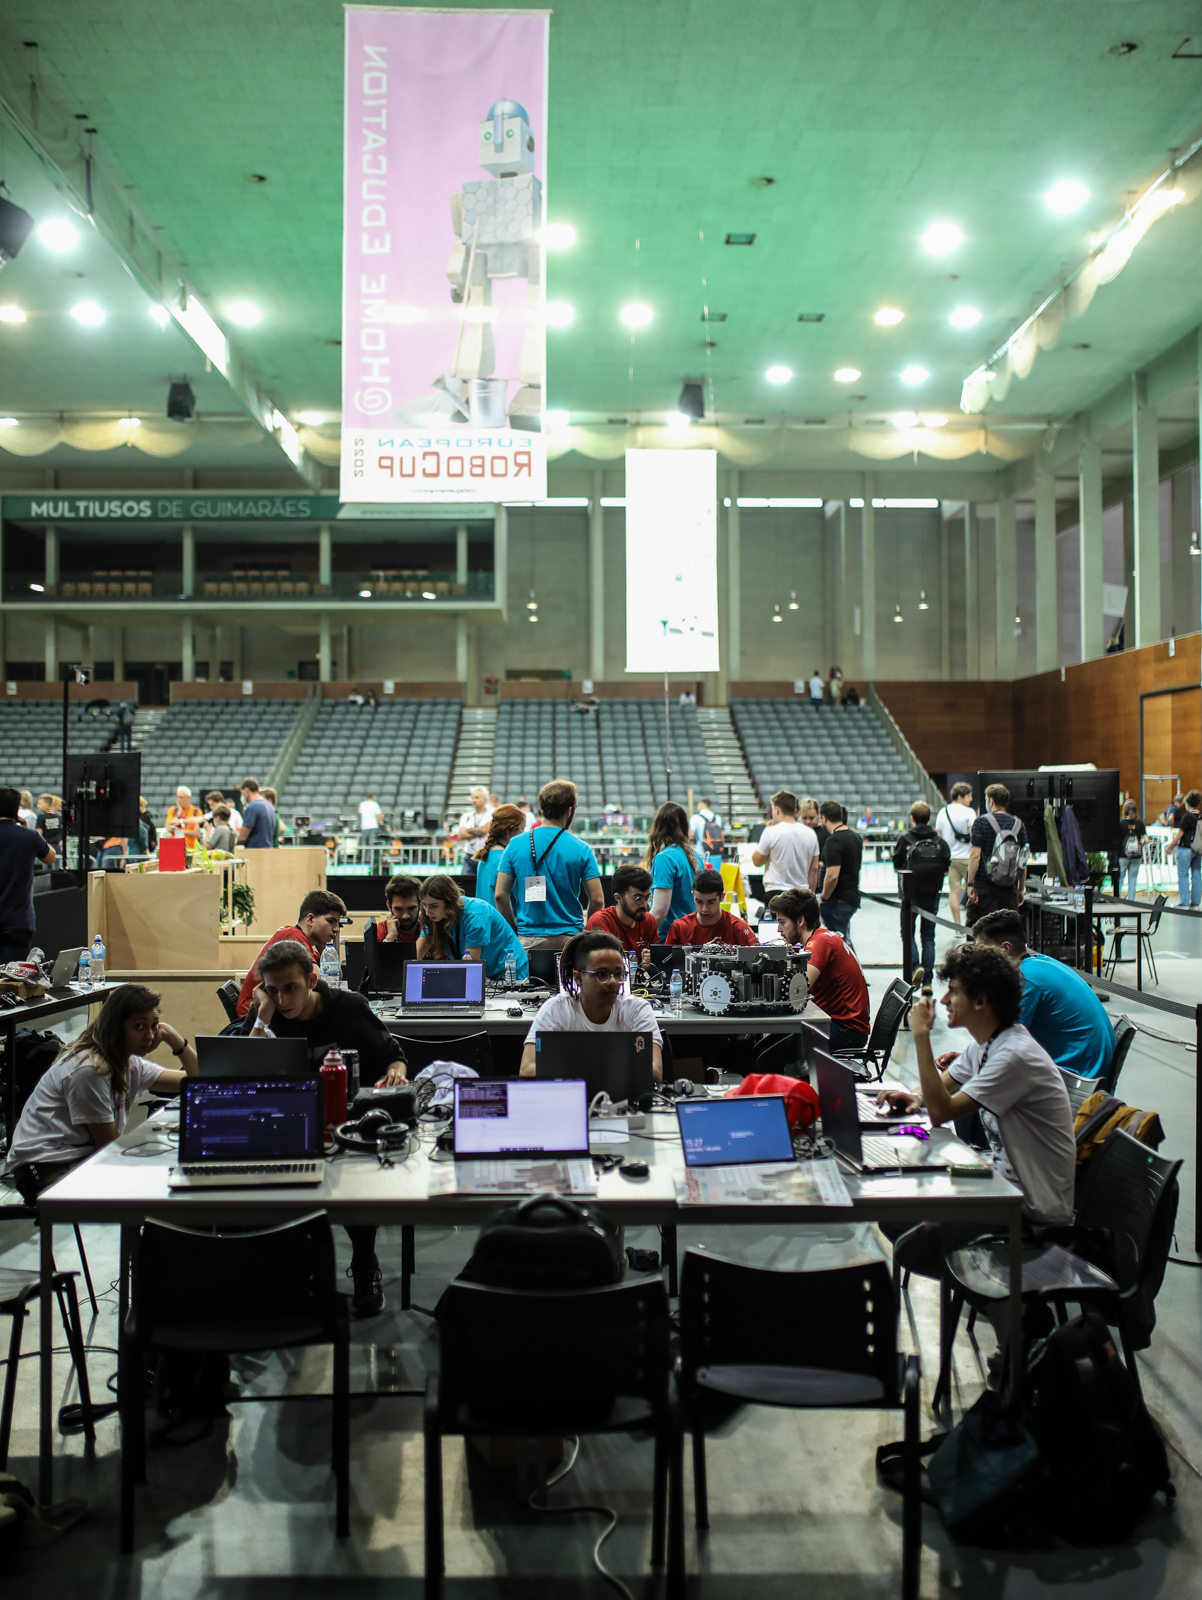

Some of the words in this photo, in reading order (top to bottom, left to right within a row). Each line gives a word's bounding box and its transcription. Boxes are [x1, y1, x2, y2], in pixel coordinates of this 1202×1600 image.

[31, 500, 152, 518] MULTIUSOS
[157, 501, 184, 518] DE
[190, 497, 312, 518] GUIMARÃES
